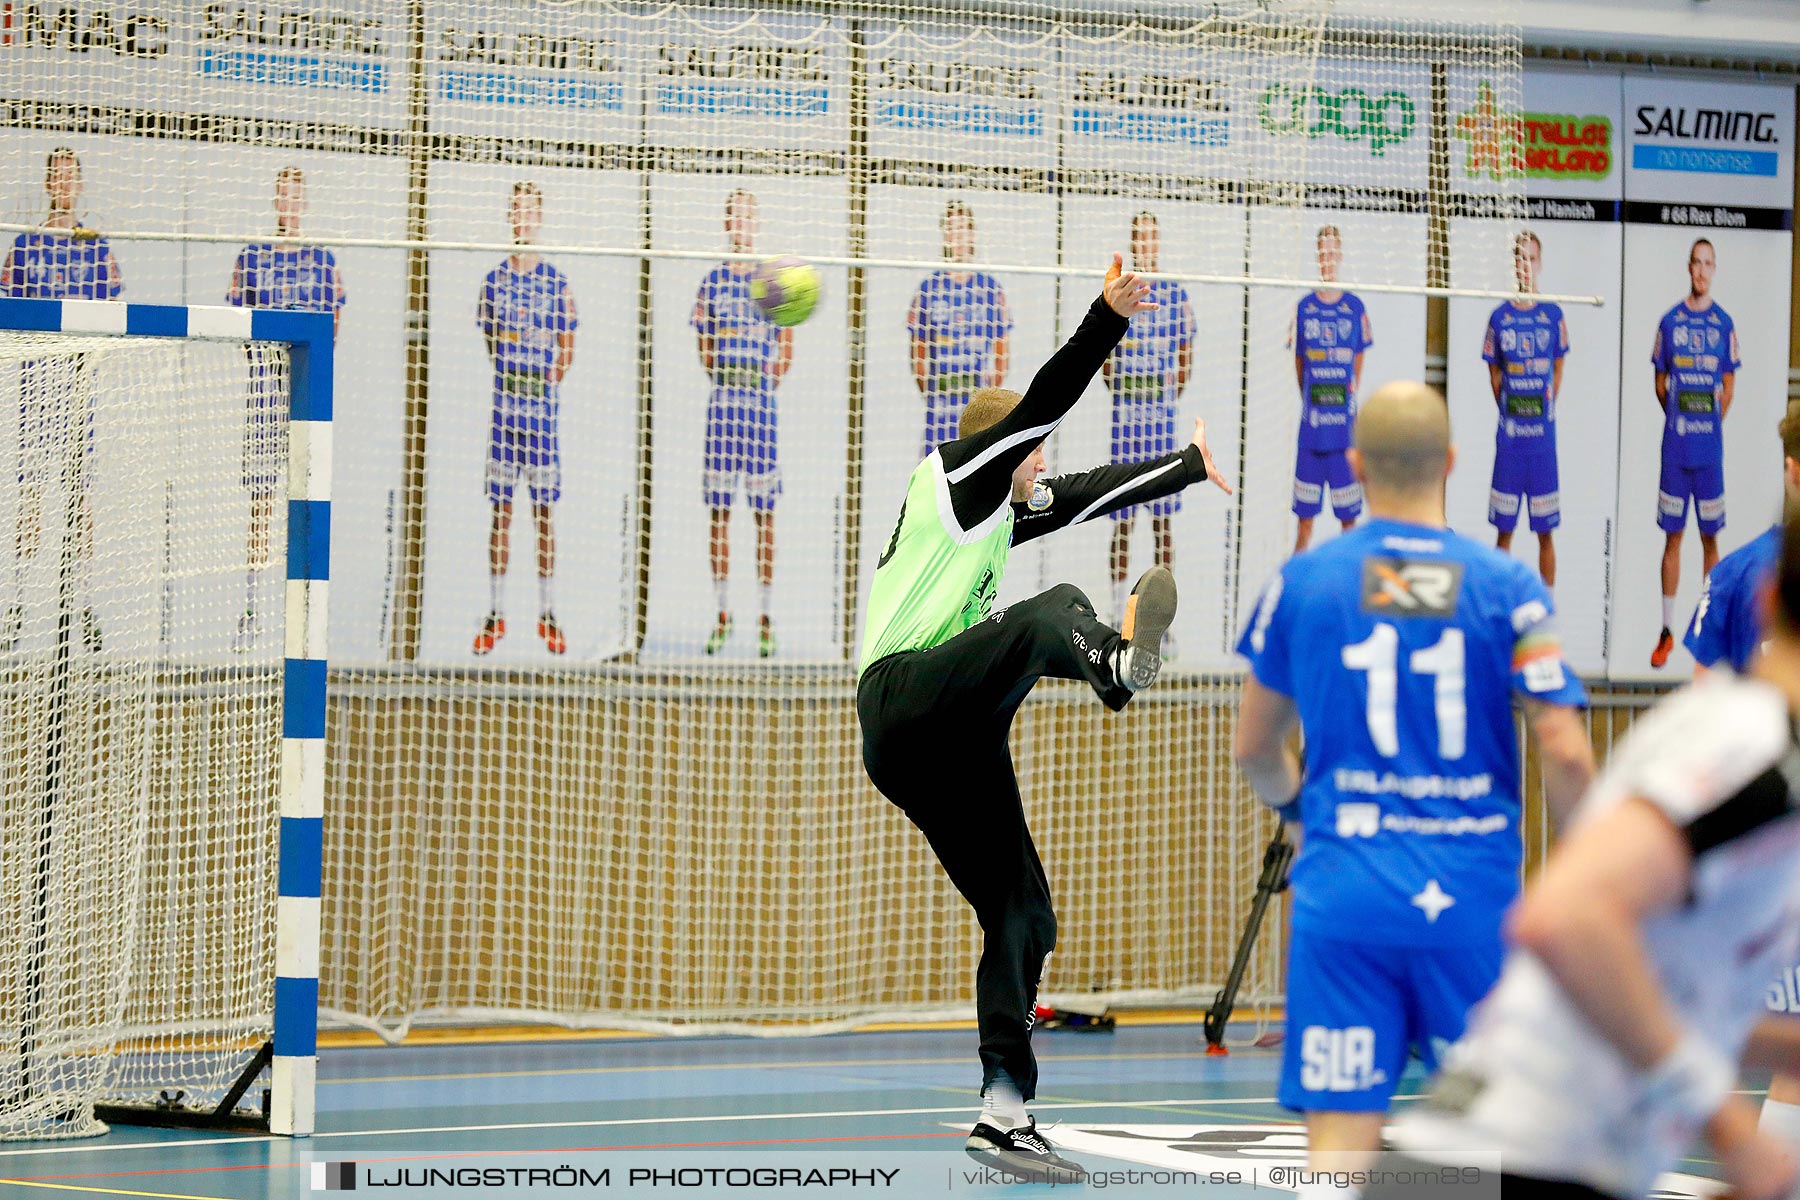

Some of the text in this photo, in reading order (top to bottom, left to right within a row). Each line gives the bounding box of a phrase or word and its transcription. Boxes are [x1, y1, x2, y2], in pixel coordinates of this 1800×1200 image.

[1689, 206, 1713, 226] Rex
[1714, 207, 1747, 228] Blom
[1341, 622, 1467, 761] 11
[1010, 1130, 1050, 1155] Salming
